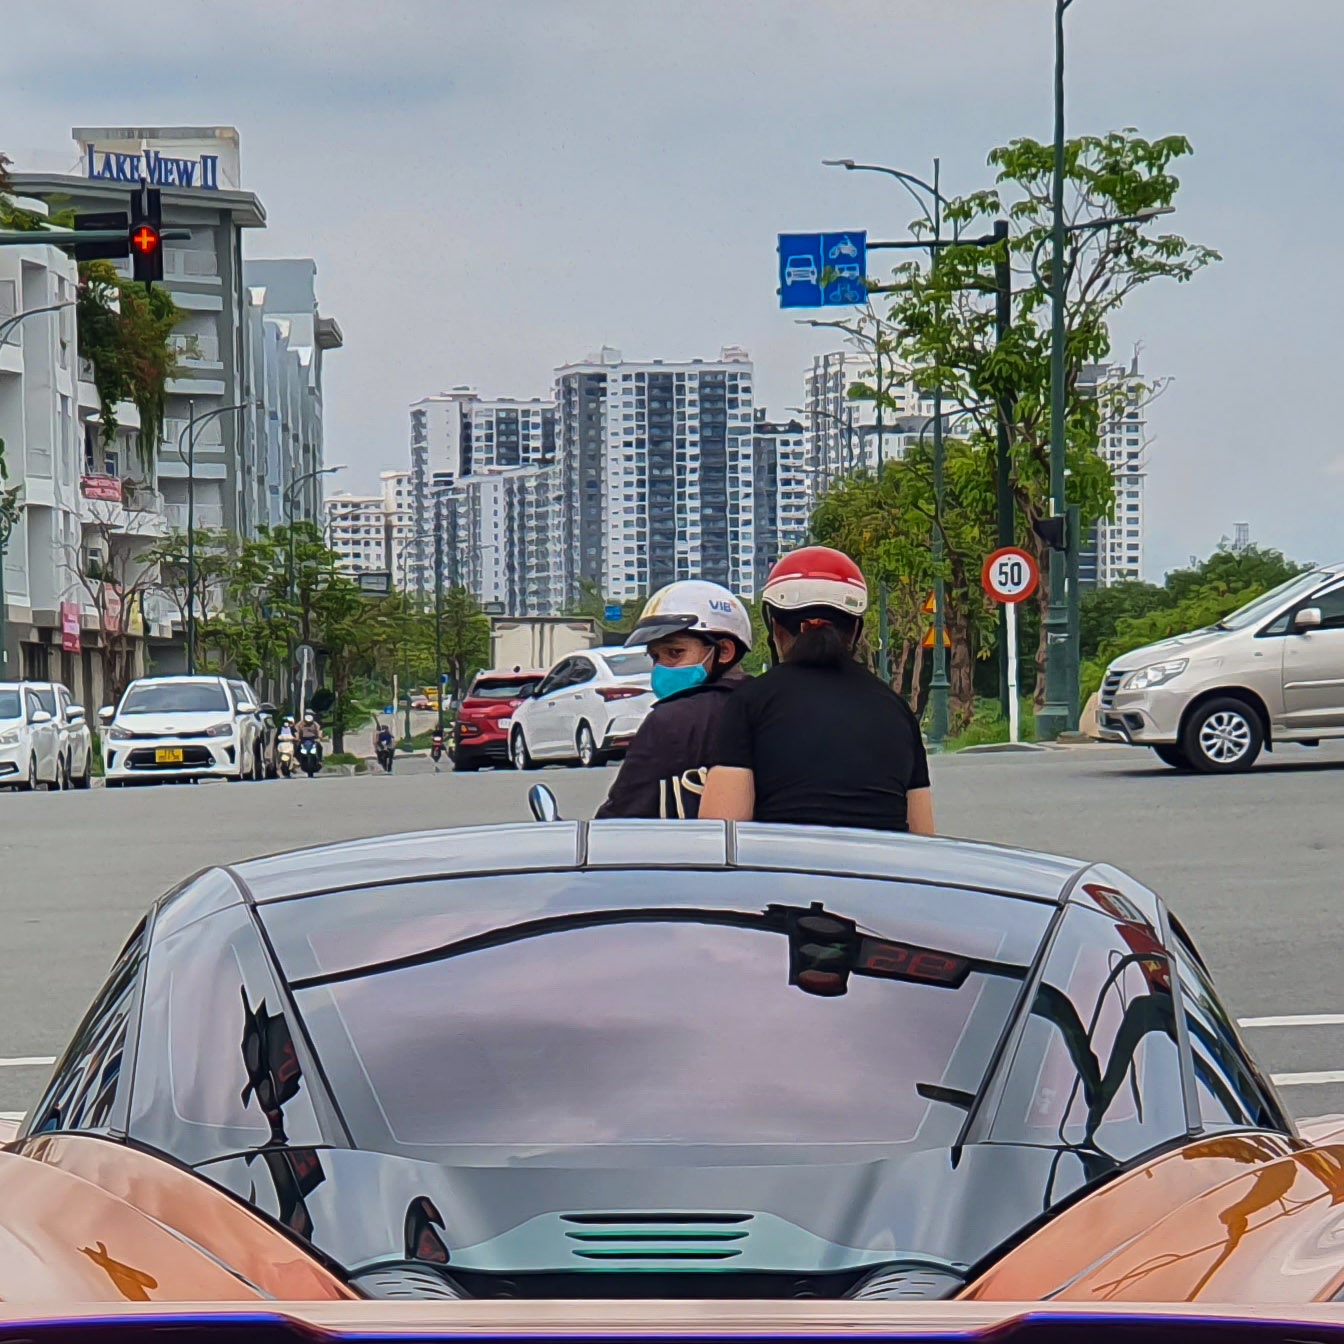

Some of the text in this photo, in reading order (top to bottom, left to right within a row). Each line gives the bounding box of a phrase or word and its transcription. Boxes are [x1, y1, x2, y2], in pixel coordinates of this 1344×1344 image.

[87, 144, 218, 191] LAKE VIEW II
[998, 561, 1022, 587] 50
[708, 599, 732, 613] VIB
